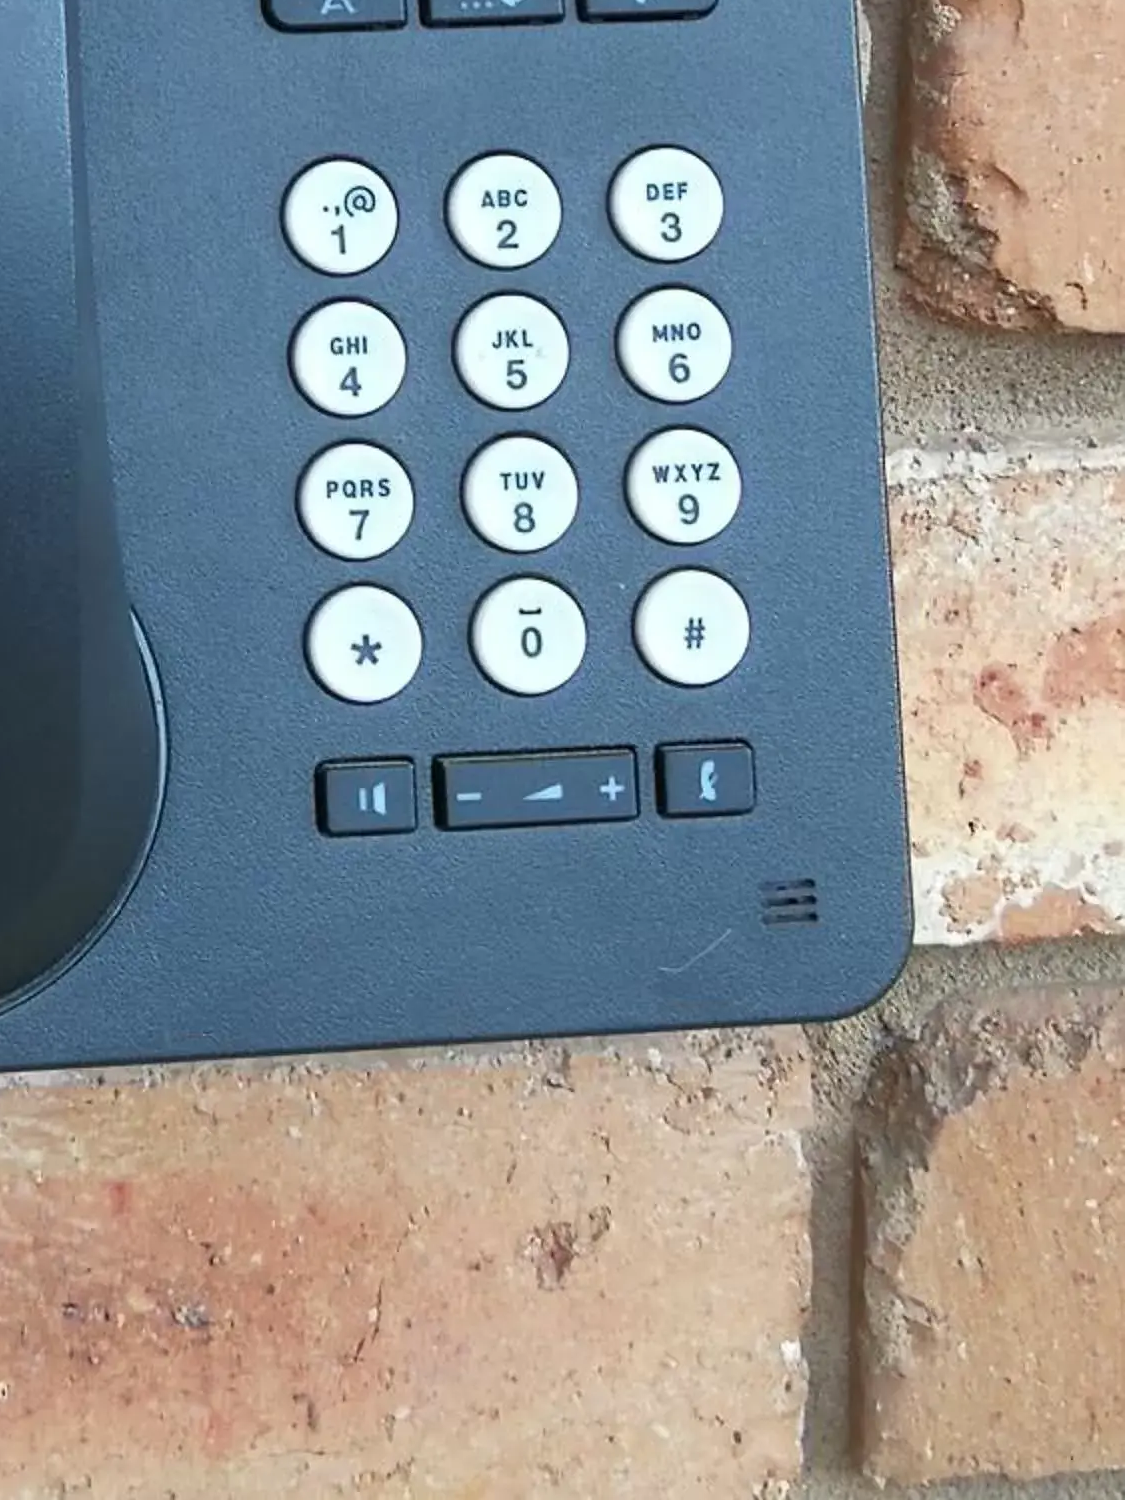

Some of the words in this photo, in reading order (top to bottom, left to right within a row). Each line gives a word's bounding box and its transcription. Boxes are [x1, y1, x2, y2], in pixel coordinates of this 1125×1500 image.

[481, 190, 528, 208] ABC
[646, 183, 689, 202] DEF
[331, 225, 347, 255] 1
[496, 220, 520, 249] 2
[660, 212, 683, 243] 3
[330, 336, 369, 356] GHI
[492, 330, 534, 350] JKL
[652, 323, 702, 343] MNO
[339, 366, 363, 398] 4
[505, 360, 528, 390] 5
[668, 353, 691, 384] 6
[501, 472, 546, 491] TUV
[653, 463, 722, 483] WXYZ
[326, 479, 391, 499] PQRS
[514, 502, 536, 534] 8
[679, 494, 701, 526] 9
[349, 509, 370, 541] 7
[520, 626, 543, 658] 0
